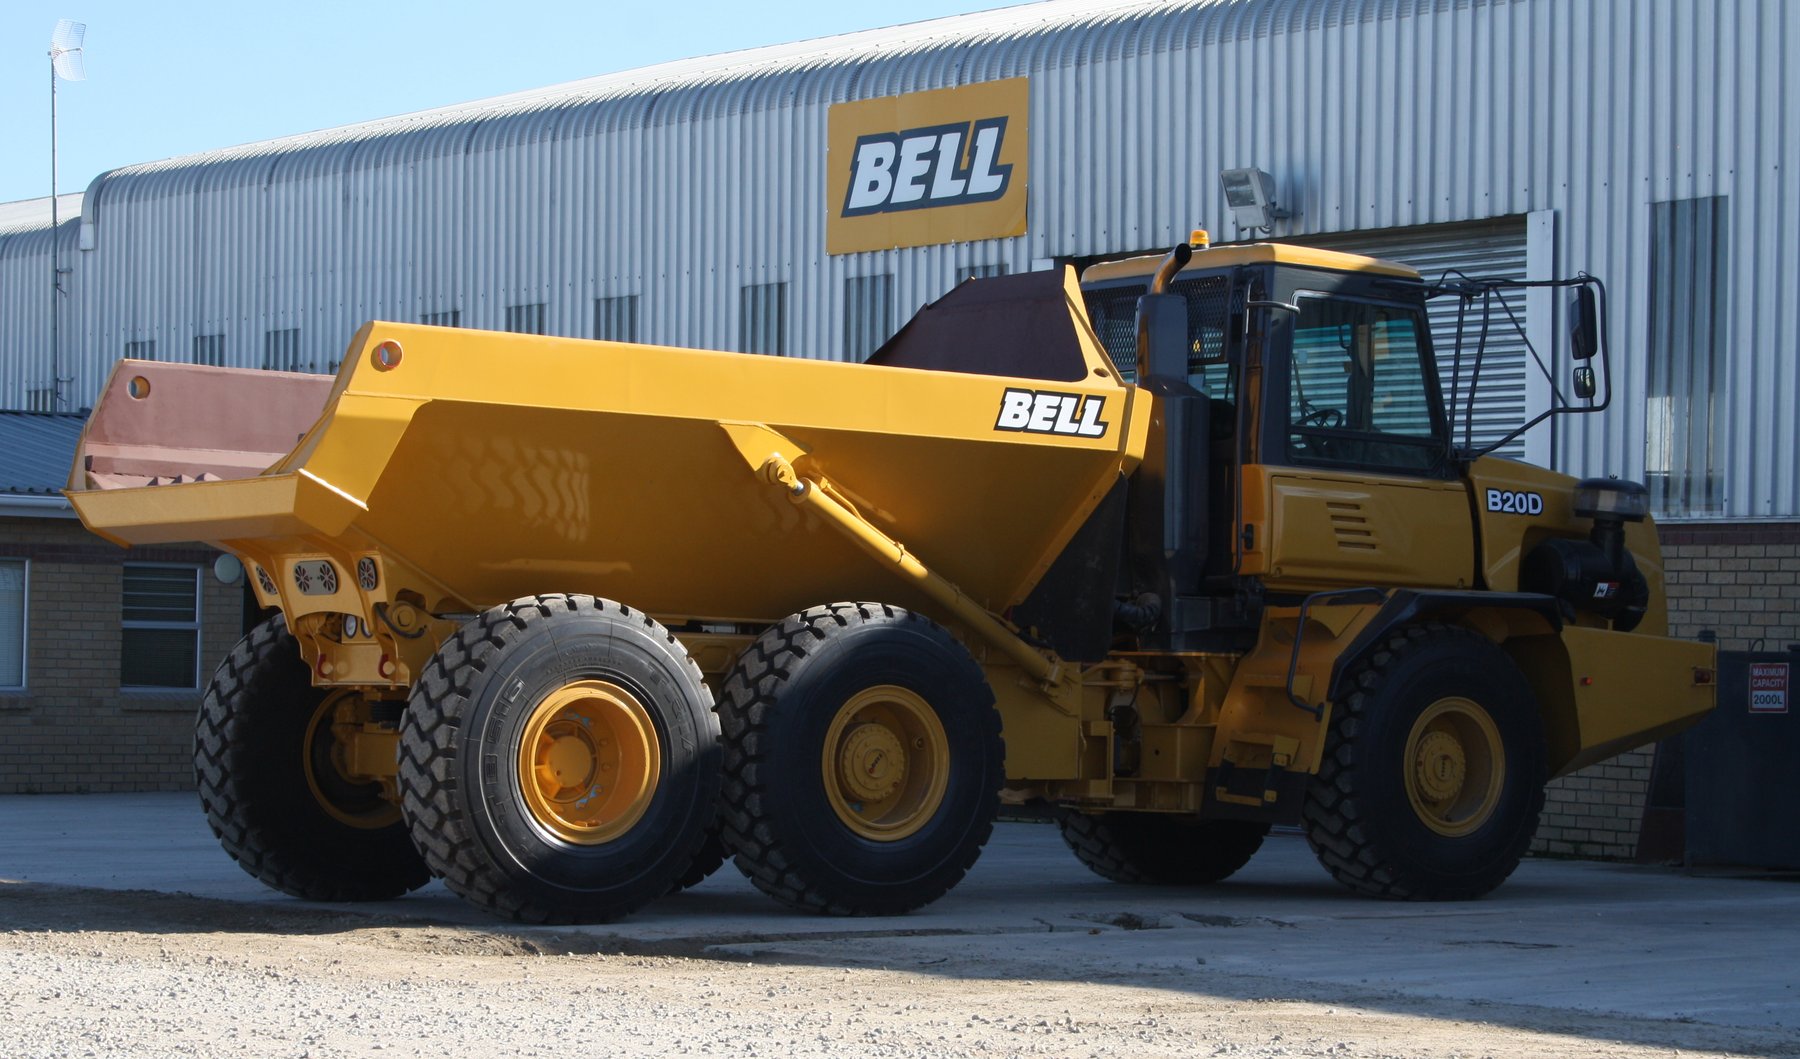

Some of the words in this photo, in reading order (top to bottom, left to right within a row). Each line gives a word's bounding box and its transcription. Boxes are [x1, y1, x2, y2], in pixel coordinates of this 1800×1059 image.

[846, 125, 1005, 209] BELL
[996, 391, 1104, 436] BELL
[1487, 489, 1543, 515] B20D
[1752, 668, 1785, 676] MAXIMUM
[1752, 678, 1785, 688] CAPACITY
[1753, 694, 1783, 705] 2000L
